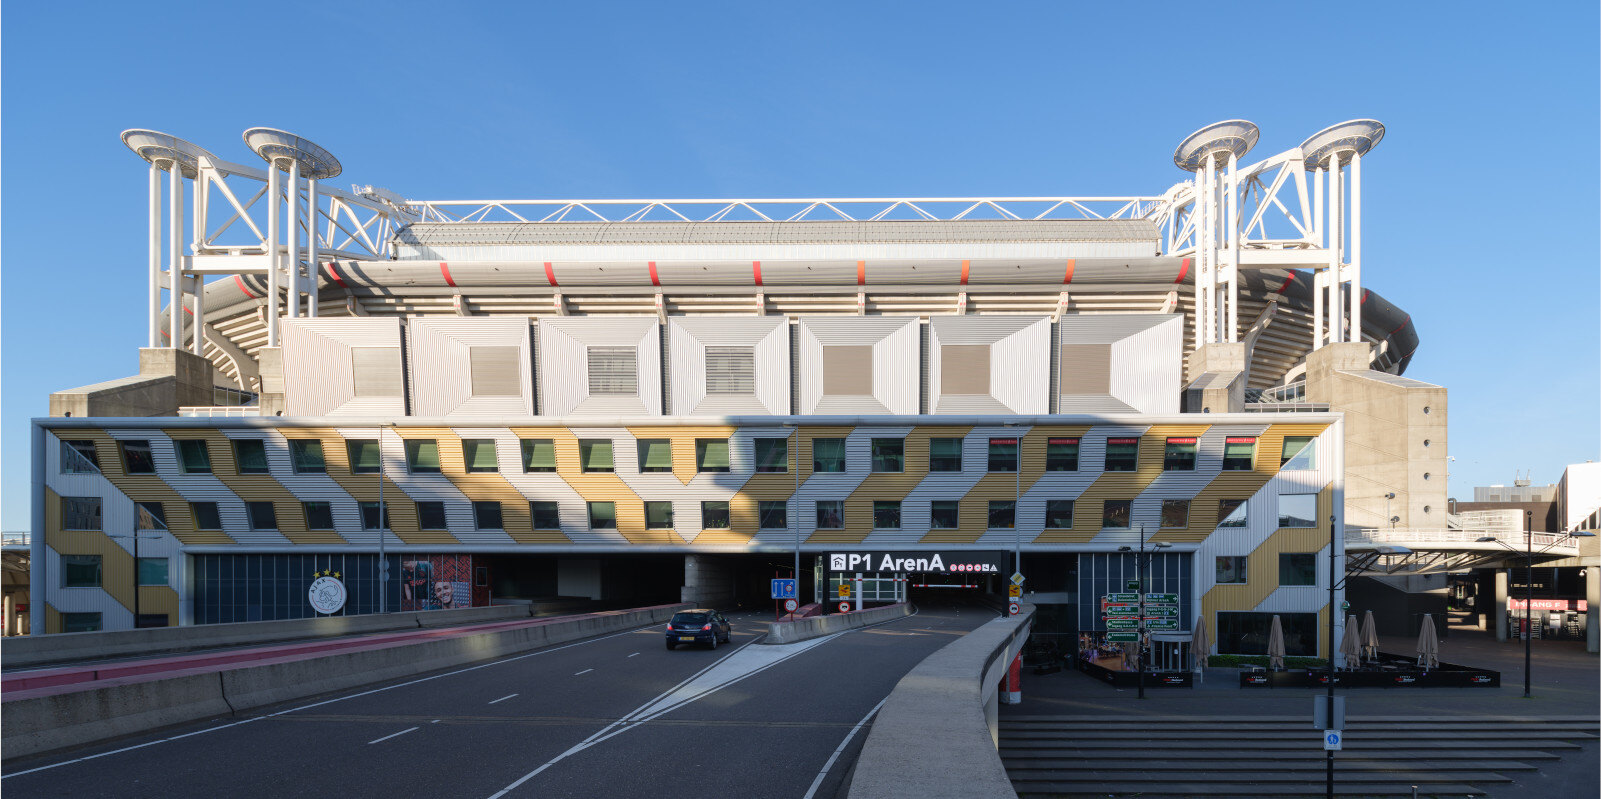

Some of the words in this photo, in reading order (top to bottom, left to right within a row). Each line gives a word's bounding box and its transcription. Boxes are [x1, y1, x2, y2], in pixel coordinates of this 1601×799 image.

[849, 553, 871, 571] P1
[879, 553, 946, 571] ArenA
[310, 578, 326, 594] AJAX
